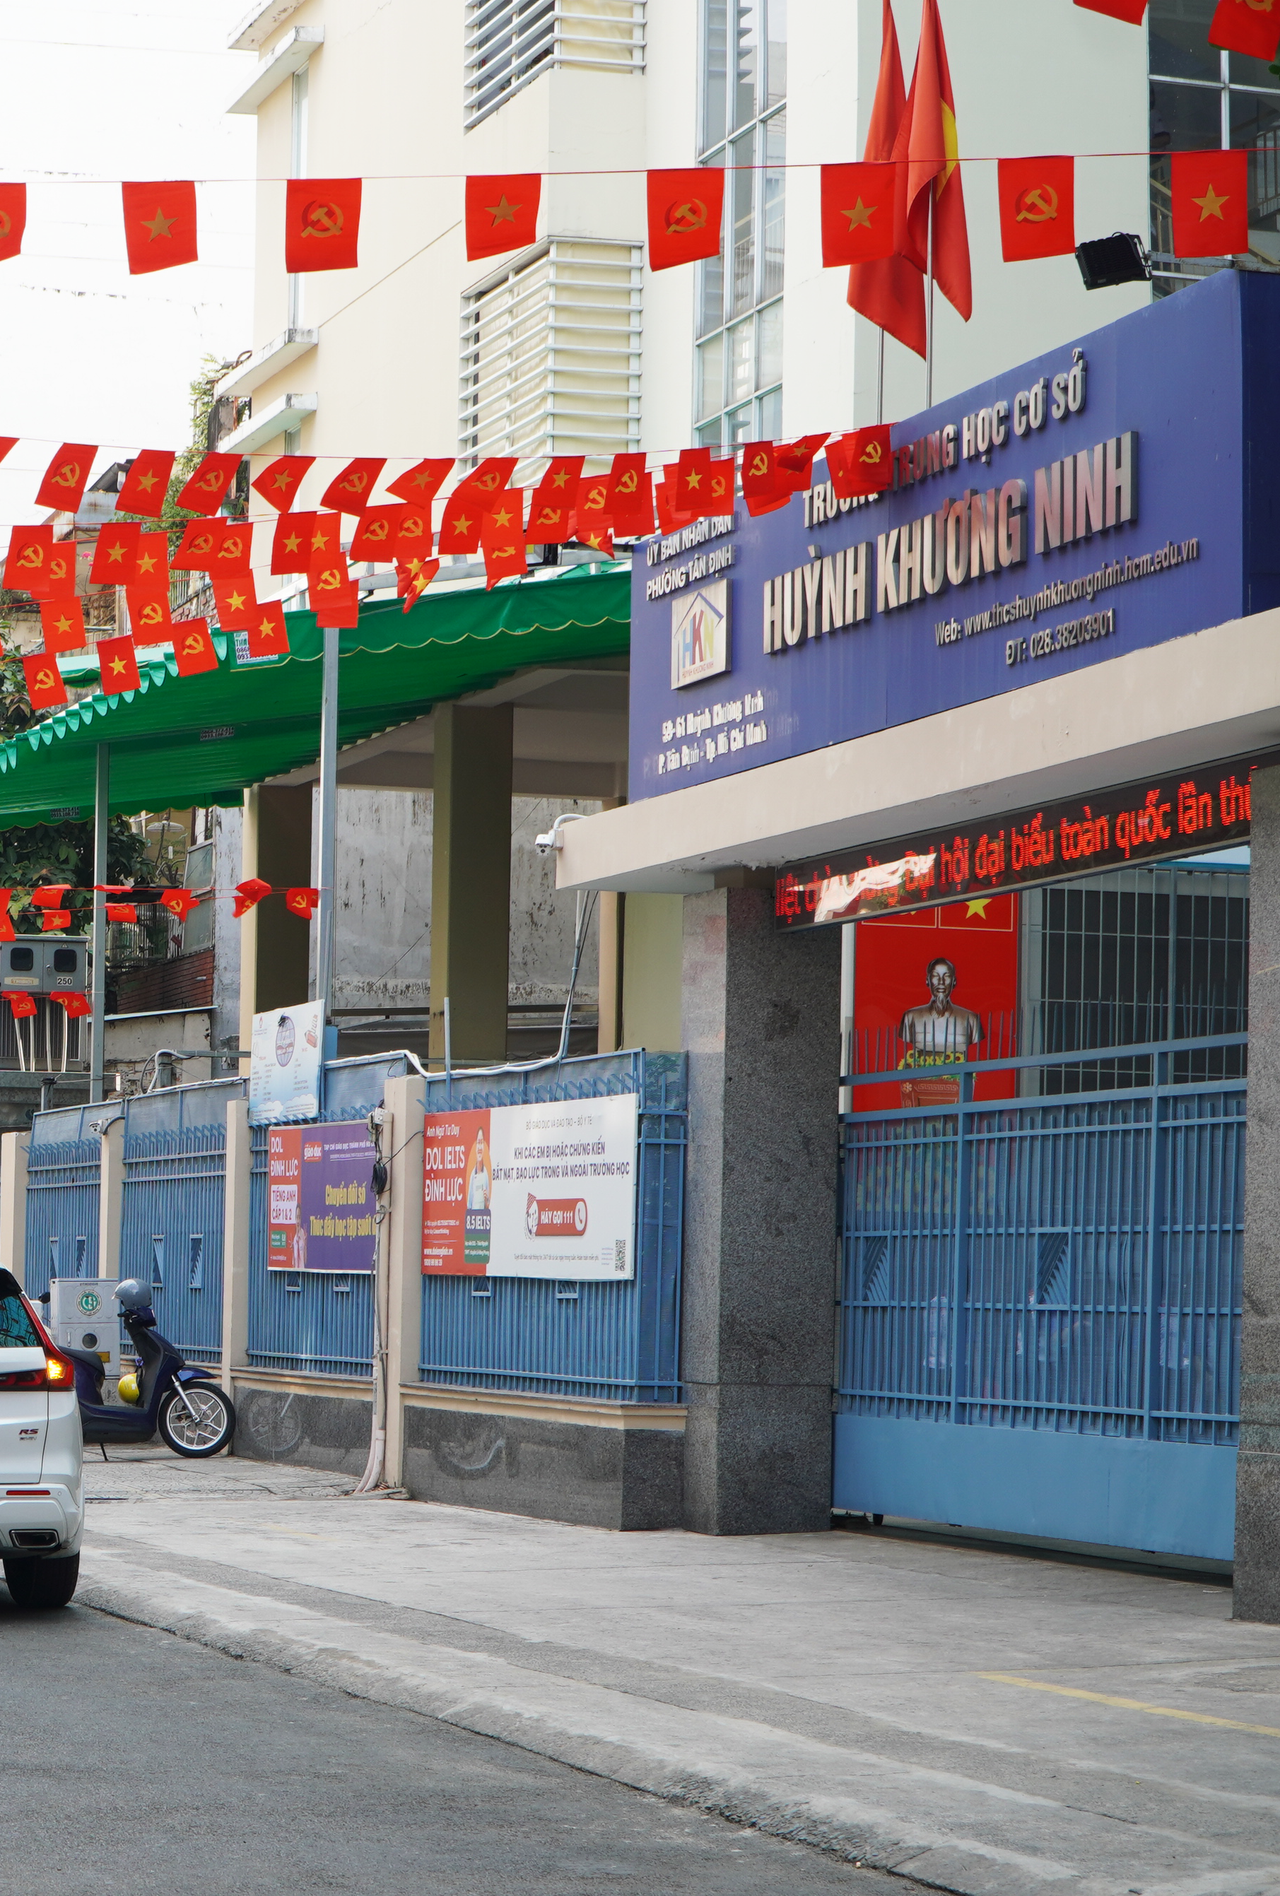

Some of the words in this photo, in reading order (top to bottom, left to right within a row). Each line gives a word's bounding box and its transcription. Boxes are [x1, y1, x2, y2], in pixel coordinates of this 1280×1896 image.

[962, 400, 1009, 465] HỌC
[1013, 376, 1048, 437] CƠ
[1051, 347, 1087, 420] SỞ
[661, 535, 680, 560] BAN
[763, 543, 872, 655] HUỲNH
[877, 479, 1027, 613] KHƯƠNG
[1034, 431, 1138, 555] NINH
[646, 566, 687, 601] PHƯỜNG
[688, 553, 707, 583] TÂN
[709, 543, 734, 578] ĐỊNH
[935, 617, 963, 646] Web:
[964, 537, 1199, 637] www.thcshuynhkhuongninh.hcm.edu.vn
[1005, 638, 1028, 665] ĐT:
[1030, 607, 1116, 659] 028.38203901
[940, 836, 969, 891] hội
[974, 829, 1005, 885] đại
[1011, 812, 1054, 870] biểu
[1060, 805, 1109, 861] toàn
[1115, 788, 1171, 859] quốc
[1177, 781, 1212, 835] lần
[57, 977, 73, 986] 250
[271, 1136, 283, 1153] DOL
[514, 1147, 523, 1160] KHI
[524, 1143, 536, 1159] CÁC
[537, 1145, 546, 1159] EM
[546, 1145, 551, 1161] BỊ
[552, 1142, 569, 1160] HOẶC
[569, 1140, 590, 1157] CHỨNG
[591, 1135, 605, 1155] KIẾN
[270, 1156, 285, 1177] ĐÌNH
[286, 1158, 298, 1180] LỰC
[426, 1147, 443, 1170] DOL
[444, 1145, 465, 1169] IELTS
[516, 1166, 527, 1183] BẠO
[528, 1164, 539, 1182] LỰC
[541, 1165, 560, 1179] TRONG
[561, 1161, 569, 1178] VÀ
[569, 1160, 588, 1178] NGOÀI
[589, 1159, 615, 1176] TRƯỜNG
[616, 1161, 630, 1179] HỌC
[425, 1173, 445, 1202] ĐÌNH
[446, 1177, 463, 1206] LỰC
[466, 1215, 476, 1230] 8.5
[476, 1215, 491, 1230] IELTS
[553, 1211, 563, 1226] GỌI
[564, 1211, 574, 1224] 111
